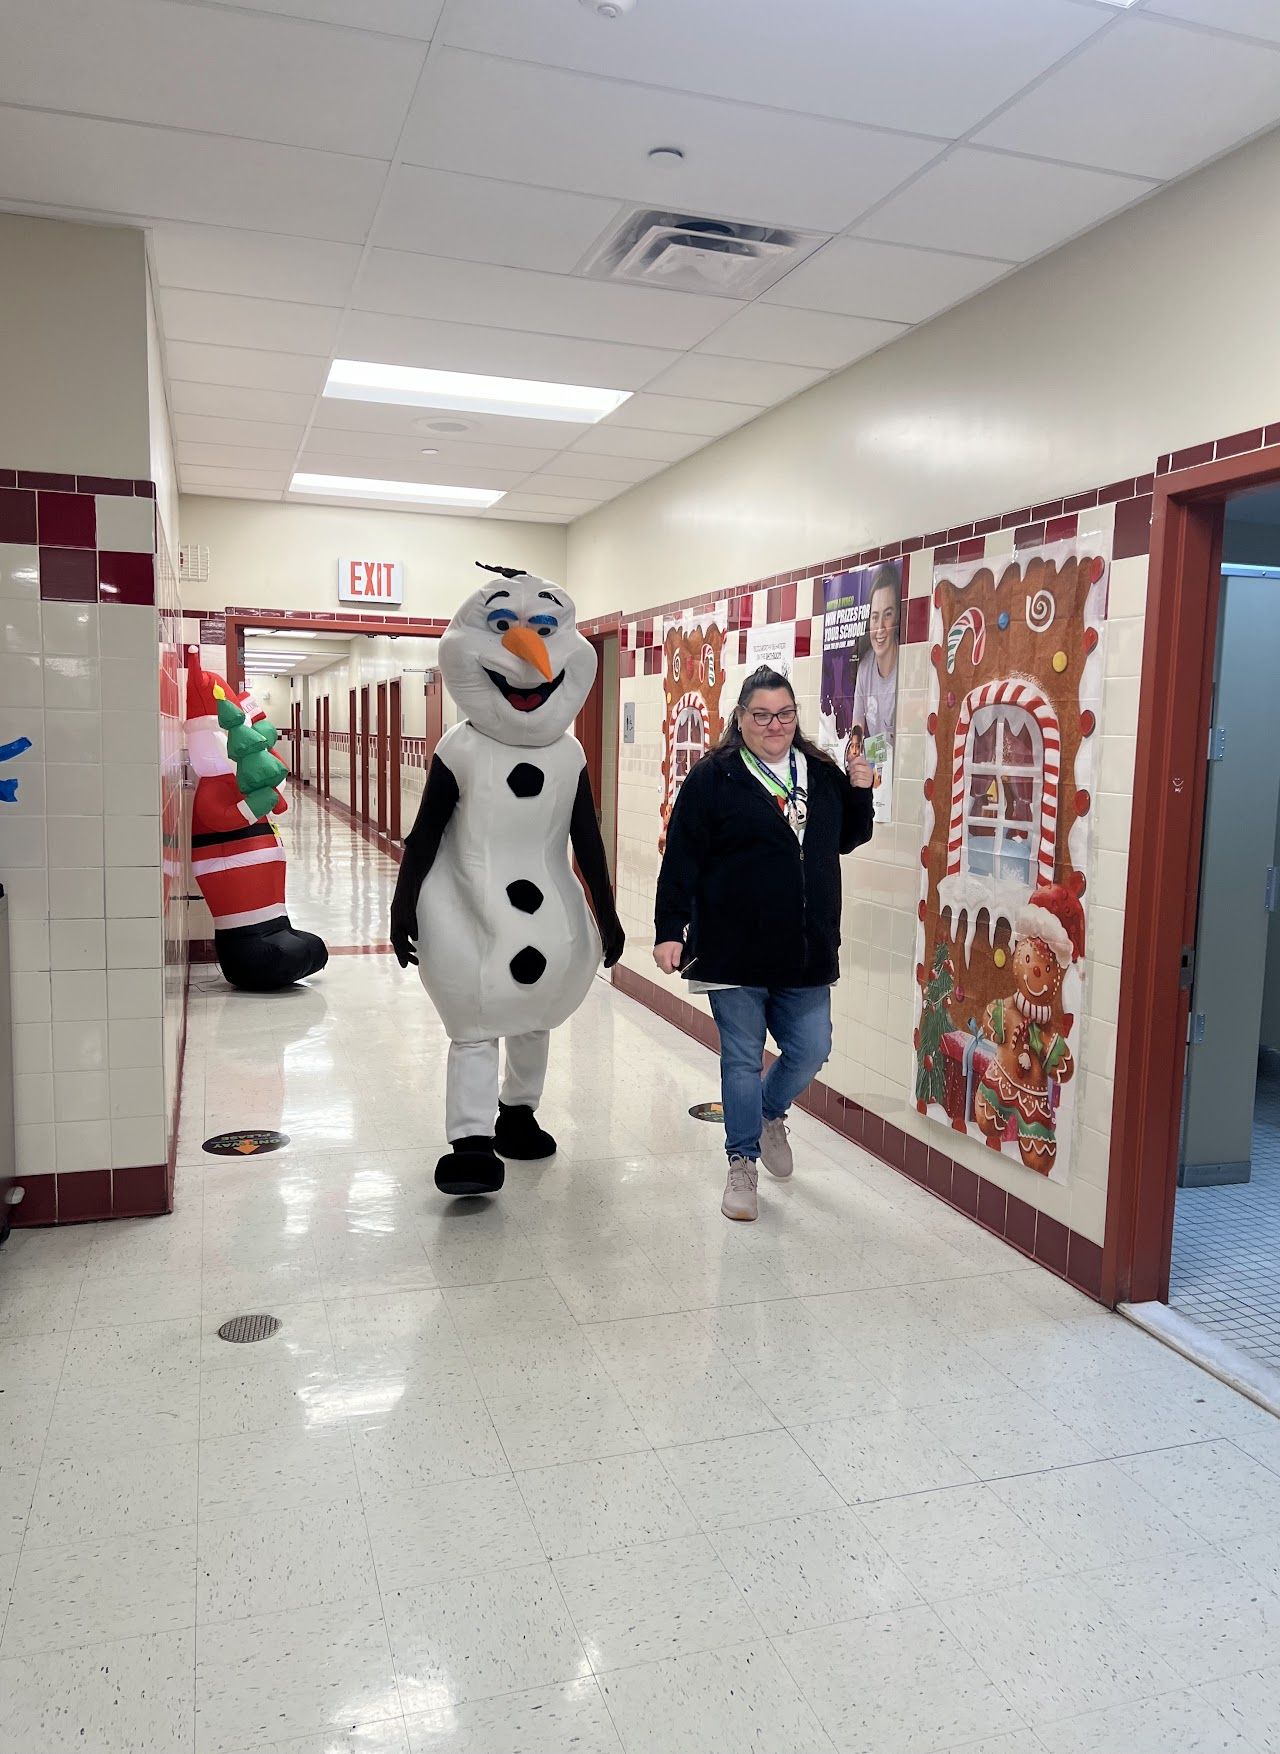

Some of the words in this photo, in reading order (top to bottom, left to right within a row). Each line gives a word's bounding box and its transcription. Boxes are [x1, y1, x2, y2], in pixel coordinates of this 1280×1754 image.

[350, 561, 395, 597] EXIT
[825, 610, 838, 627] WIN
[836, 605, 859, 625] PRIZES
[858, 603, 871, 620] FOR
[824, 626, 840, 642] YOUR
[840, 620, 867, 640] SCHOOL!
[212, 1141, 242, 1149] WAY
